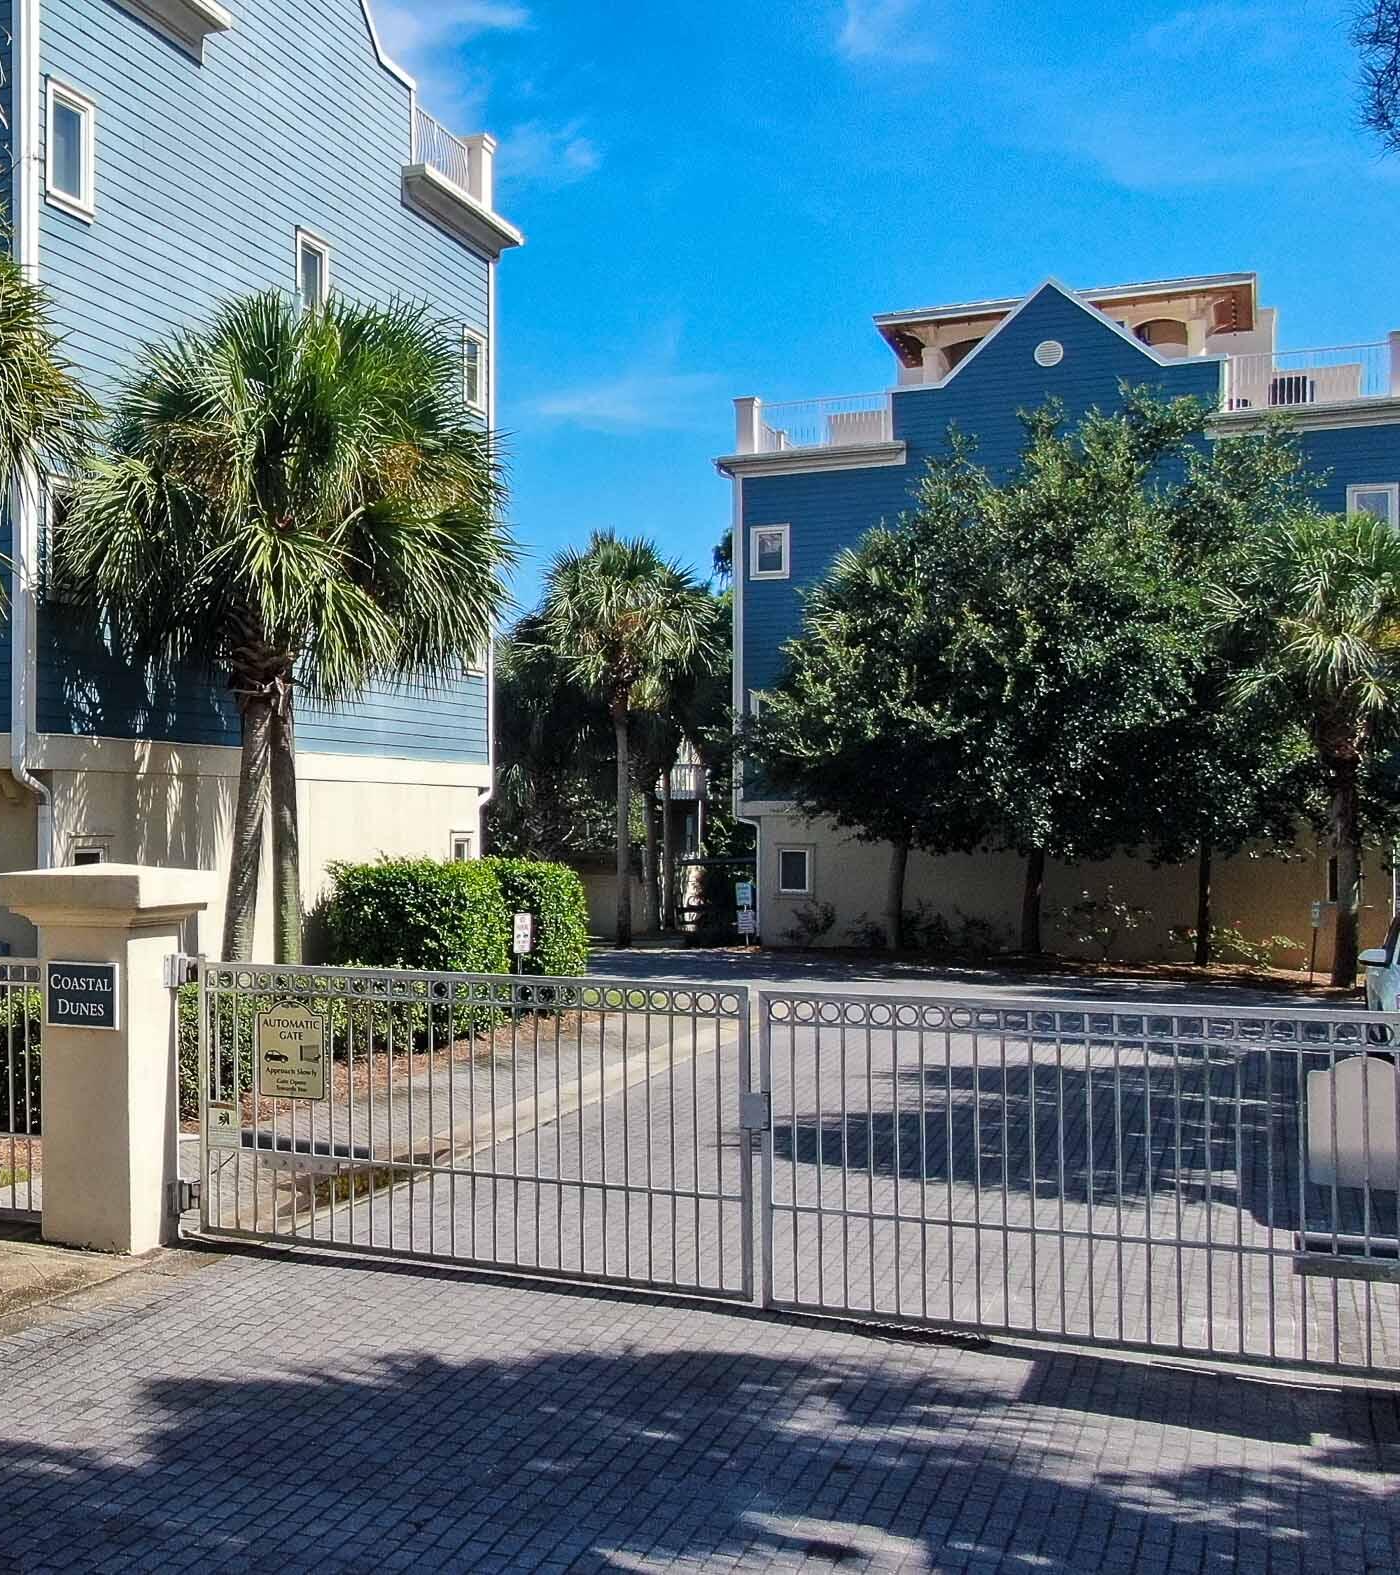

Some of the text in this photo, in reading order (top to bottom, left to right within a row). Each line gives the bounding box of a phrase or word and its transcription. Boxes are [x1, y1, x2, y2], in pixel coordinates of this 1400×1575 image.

[50, 973, 112, 991] COASTAL
[57, 998, 104, 1016] DUNES
[263, 1019, 320, 1030] AUTOMATIC
[279, 1031, 303, 1040] GATE
[266, 1067, 317, 1077] Approach Slowly
